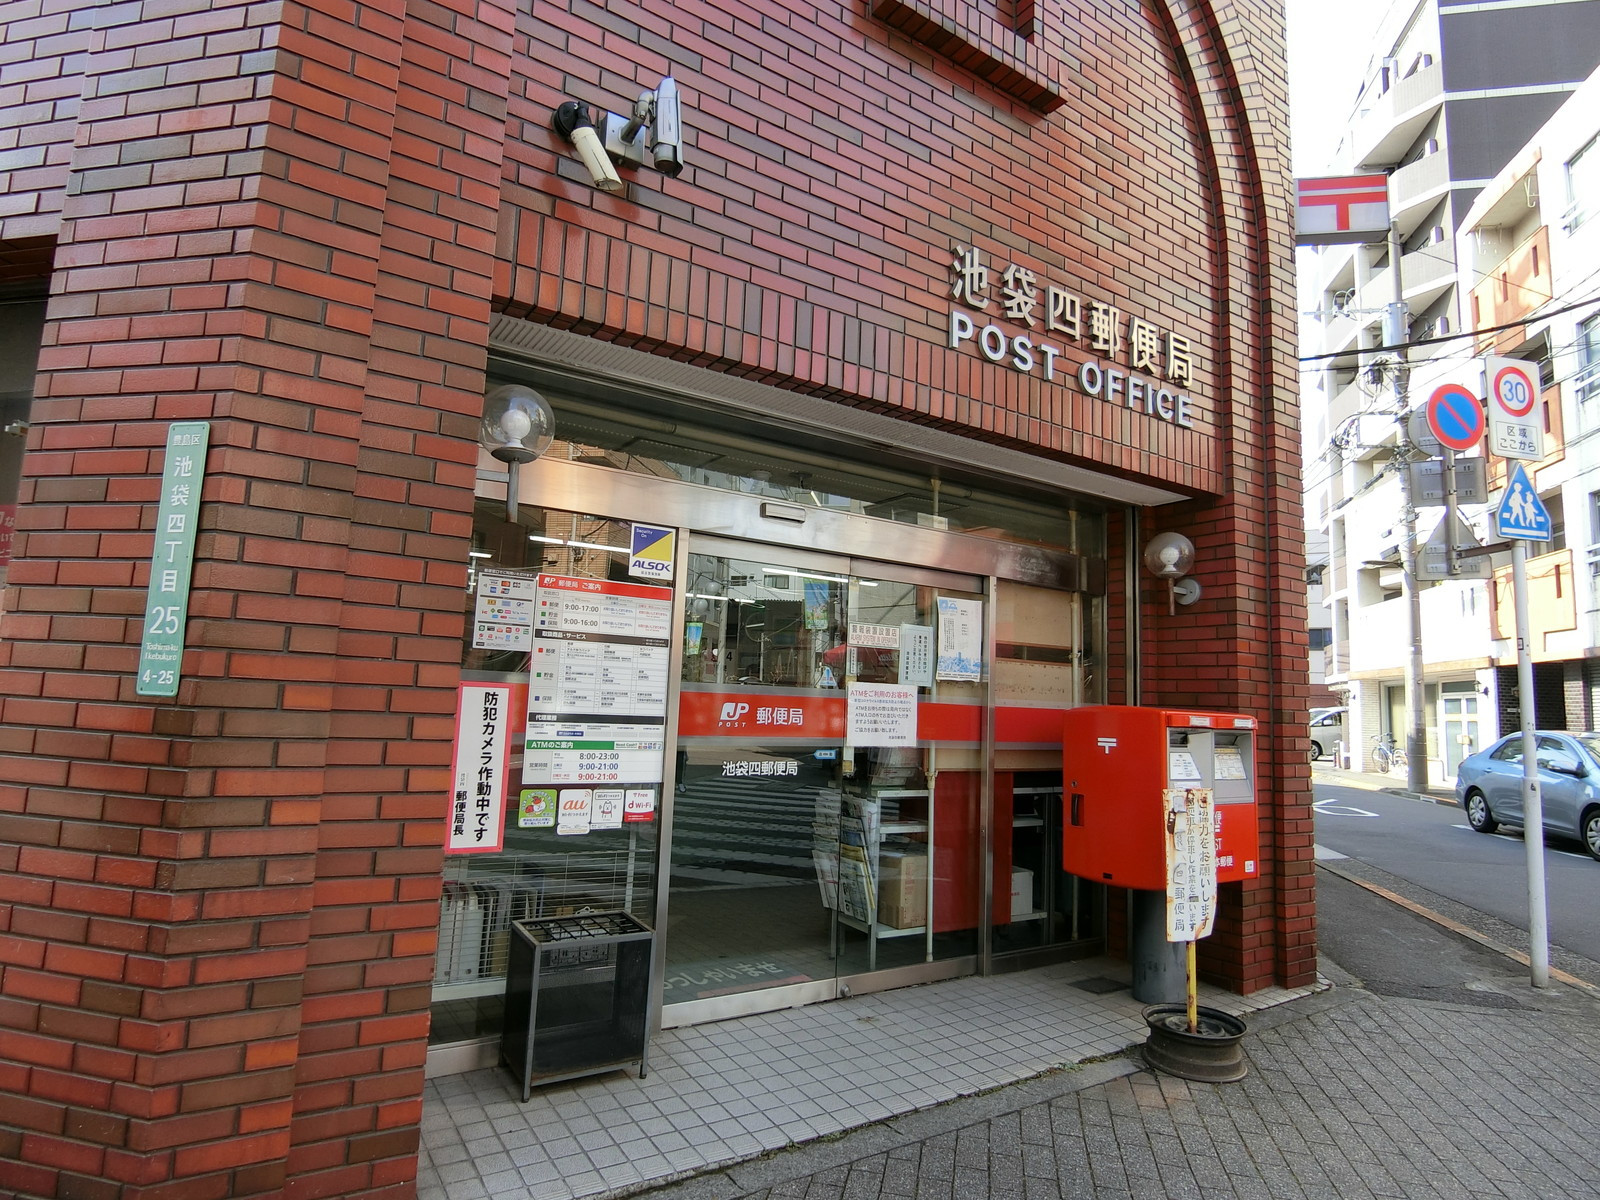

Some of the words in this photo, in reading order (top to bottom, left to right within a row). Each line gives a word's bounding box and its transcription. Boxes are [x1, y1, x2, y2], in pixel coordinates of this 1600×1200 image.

[950, 244, 1193, 388] 池袋四郵便局
[949, 310, 1060, 380] POST
[1078, 361, 1194, 428] OFFICE
[1503, 380, 1526, 404] 30
[1507, 425, 1528, 438] 区域
[172, 434, 201, 446] 豊島区
[1500, 437, 1537, 453] ここから
[161, 455, 193, 593] 池袋四丁目
[632, 560, 671, 573] ALSOK
[564, 603, 599, 613] 9:00-17:00
[149, 606, 180, 635] 25
[563, 617, 599, 627] 9:00-16:00
[144, 651, 177, 662] Ikebukuro
[142, 669, 174, 685] 4-25
[756, 707, 804, 726] 郵便局
[531, 741, 574, 749] ATMのご案内
[579, 752, 619, 760] 8:00-23:00
[473, 691, 499, 842] 防犯カメラ作動中です
[578, 762, 619, 771] 9:00-21:00
[722, 761, 798, 776] 池袋四郵便局
[577, 772, 618, 781] 9:00-21:00
[563, 800, 588, 811] au
[453, 790, 467, 836] 郵便局長
